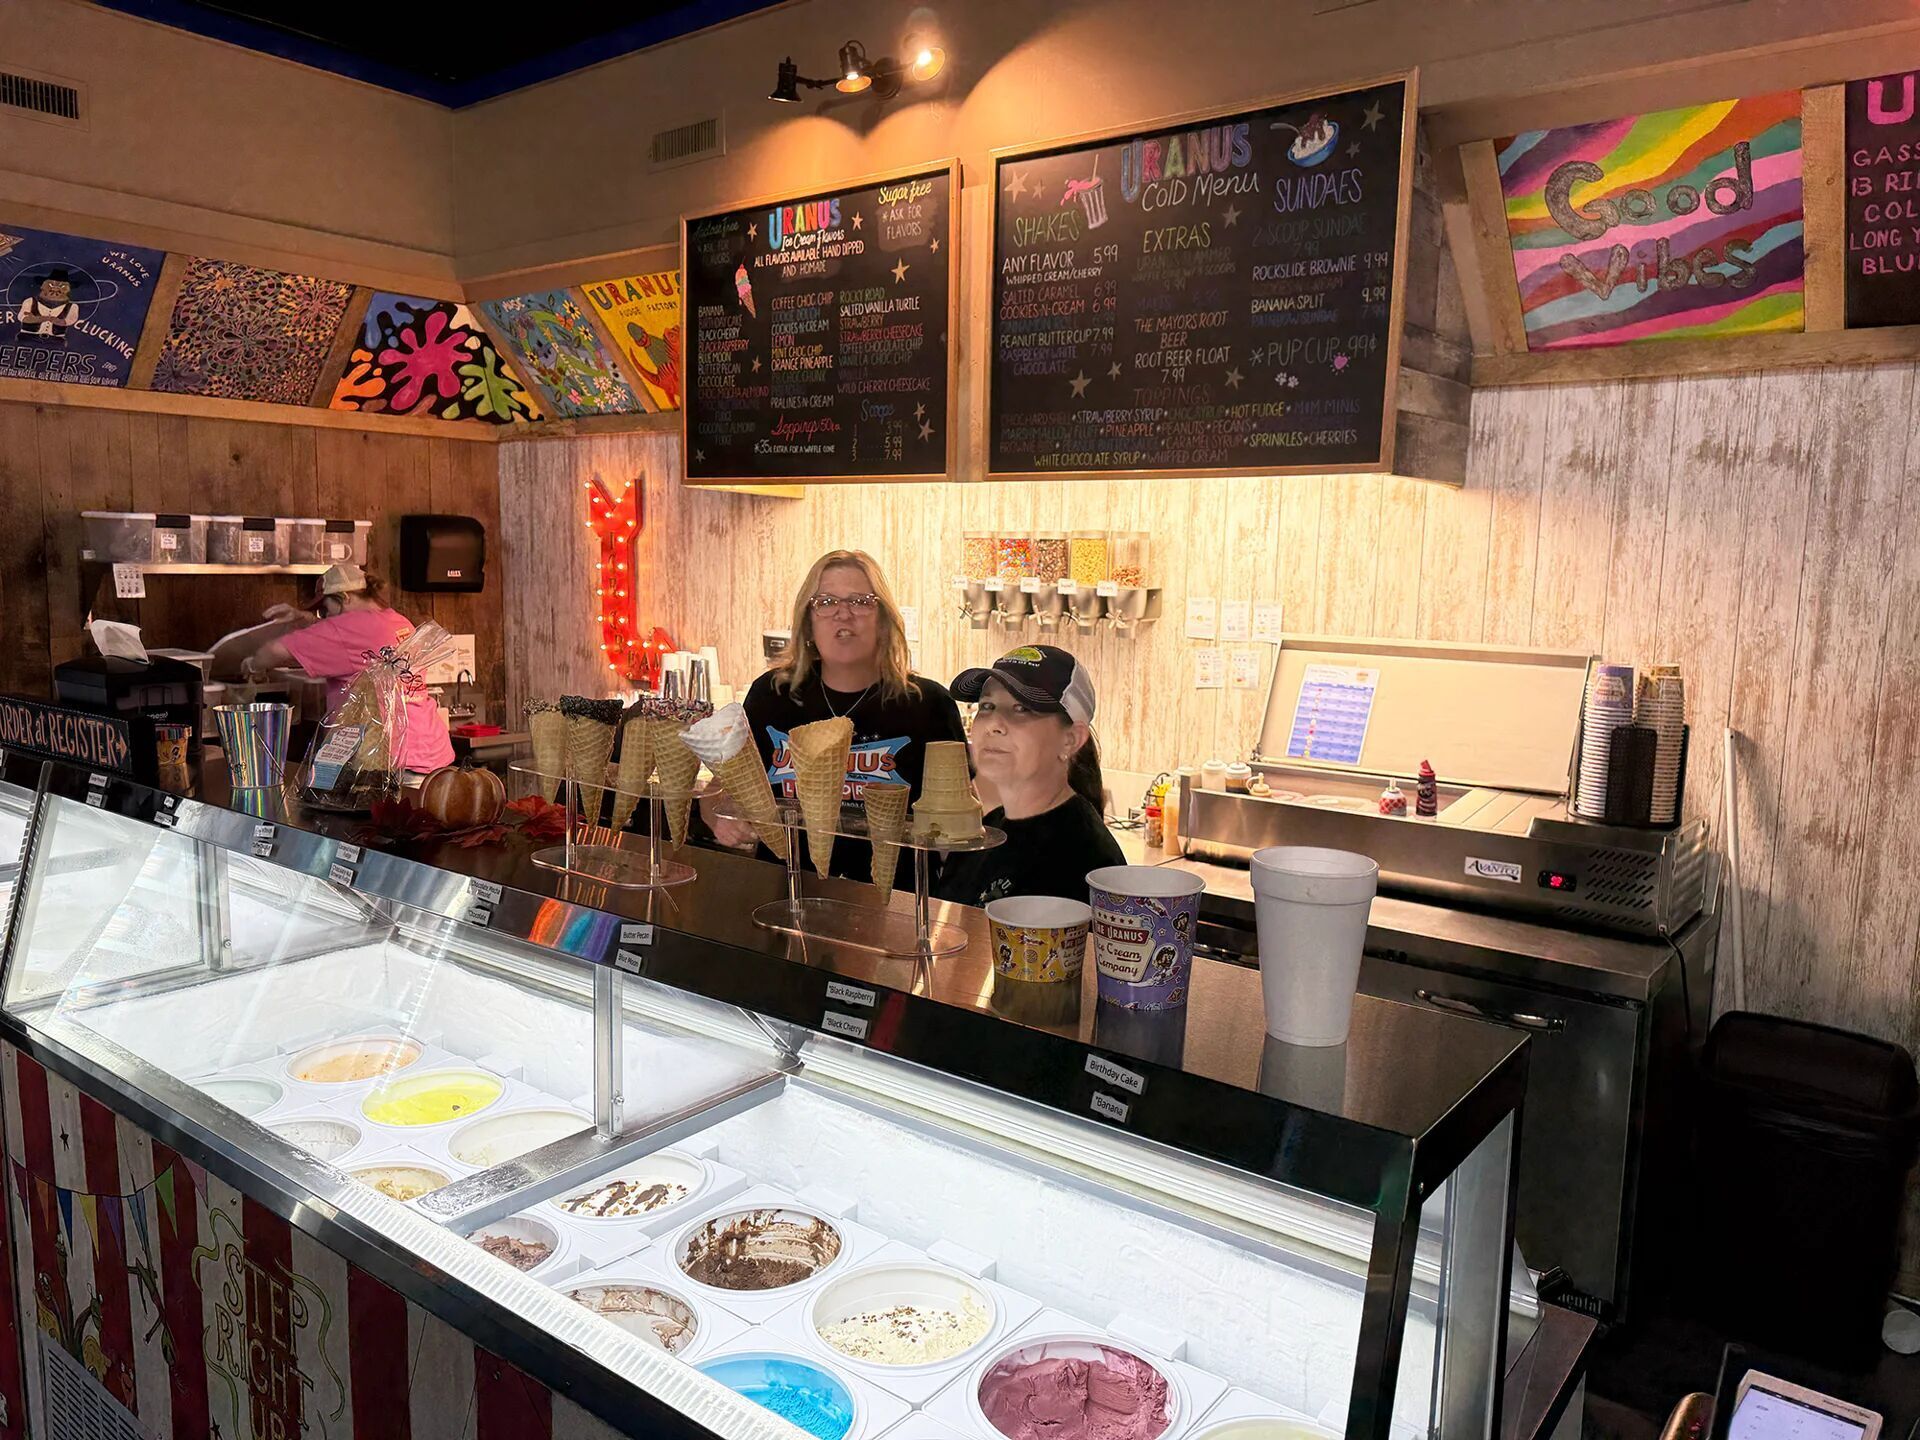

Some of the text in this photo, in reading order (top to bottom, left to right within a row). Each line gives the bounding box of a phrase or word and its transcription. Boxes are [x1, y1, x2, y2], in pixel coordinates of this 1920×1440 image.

[1120, 123, 1253, 204] URANUS
[878, 186, 909, 208] Sugar
[1191, 172, 1260, 207] Menu
[1273, 168, 1363, 213] SUNDAES
[1544, 141, 1753, 240] Good
[889, 204, 922, 222] ASK FOR
[769, 199, 842, 250] URANUS
[886, 221, 922, 240] FLAVORS
[1013, 209, 1080, 248] SHAKES
[1312, 212, 1367, 241] SUNDAE
[793, 233, 817, 250] Cream
[1143, 221, 1211, 253] EXTRAS
[1849, 228, 1902, 250] LONG
[765, 252, 790, 267] FLAVORS
[790, 247, 820, 264] AVAILABLE
[822, 241, 842, 258] HAND
[842, 239, 865, 257] DIPPED
[1002, 255, 1028, 274] ANY
[1030, 250, 1075, 271] FLAVOR
[101, 256, 142, 288] URANUS
[109, 250, 150, 280] WE LOVE
[781, 266, 796, 279] AND
[1252, 260, 1308, 282] ROCKSLIDE
[1309, 254, 1357, 276] BROWNIE
[1558, 236, 1759, 300] Vibes
[1862, 253, 1920, 275] BLU
[1006, 266, 1103, 286] WHIPPED CREAM/CHERRY
[771, 291, 834, 311] COFFEE CHOC CHIP
[840, 289, 863, 304] ROCKY
[1002, 283, 1080, 305] SALTED CARAMEL
[1251, 297, 1295, 315] BANANA
[1296, 292, 1325, 311] SPLIT
[646, 300, 679, 312] FACTORY
[698, 304, 725, 317] BANANA
[840, 296, 920, 317] SALTED VANILLA TURTLE
[840, 314, 885, 330] STRAWBERRY
[883, 322, 924, 338] CHEESECAKE
[1134, 310, 1230, 333] THE MAYORS ROOT
[73, 319, 135, 360] CLUCKING
[771, 335, 796, 347] LEMON
[864, 338, 905, 353] CHOCOLATE
[905, 336, 924, 351] CHIP
[1000, 332, 1037, 349] PEANUT
[1160, 331, 1188, 349] BEER
[711, 350, 732, 363] MOON
[788, 346, 806, 358] CHOC
[870, 352, 891, 365] CHOC
[894, 351, 912, 365] CHIP
[1134, 345, 1231, 369] ROOT BEER FLOAT
[1267, 338, 1302, 367] PUP
[1304, 336, 1340, 364] CUP
[771, 355, 834, 372] ORANGE PINEAPPLE
[697, 374, 736, 388] CHOCOLATE
[837, 376, 932, 394] WILD CHERRY CHEESECAKE
[1133, 383, 1211, 407] TOPPINGS
[1077, 409, 1134, 424] STRAWBERRY
[1134, 408, 1164, 423] SYRUP
[1230, 404, 1250, 419] HOT
[1252, 400, 1285, 418] FUDGE
[770, 413, 820, 443] Toppings
[1105, 422, 1154, 438] PINEAPPLE
[1211, 419, 1251, 435] PECANS
[1249, 431, 1303, 448] SPRINKLES
[1308, 428, 1359, 446] CHERRIES
[851, 437, 859, 449] 2
[851, 448, 857, 462] 3
[1033, 453, 1060, 467] WHITE
[1060, 451, 1110, 466] CHOCOLATE
[1113, 450, 1140, 465] SYRUP
[0, 702, 35, 747] ORDER
[48, 711, 119, 769] REGISTER
[1107, 926, 1144, 942] URANUS
[1107, 942, 1142, 960] Cream
[1098, 953, 1138, 977] Company
[845, 987, 874, 1003] Raspberry
[843, 1021, 863, 1034] Cherry
[1090, 1060, 1139, 1088] Birthday Cake
[223, 1243, 309, 1357] STEP
[215, 1302, 314, 1430] RIGHT
